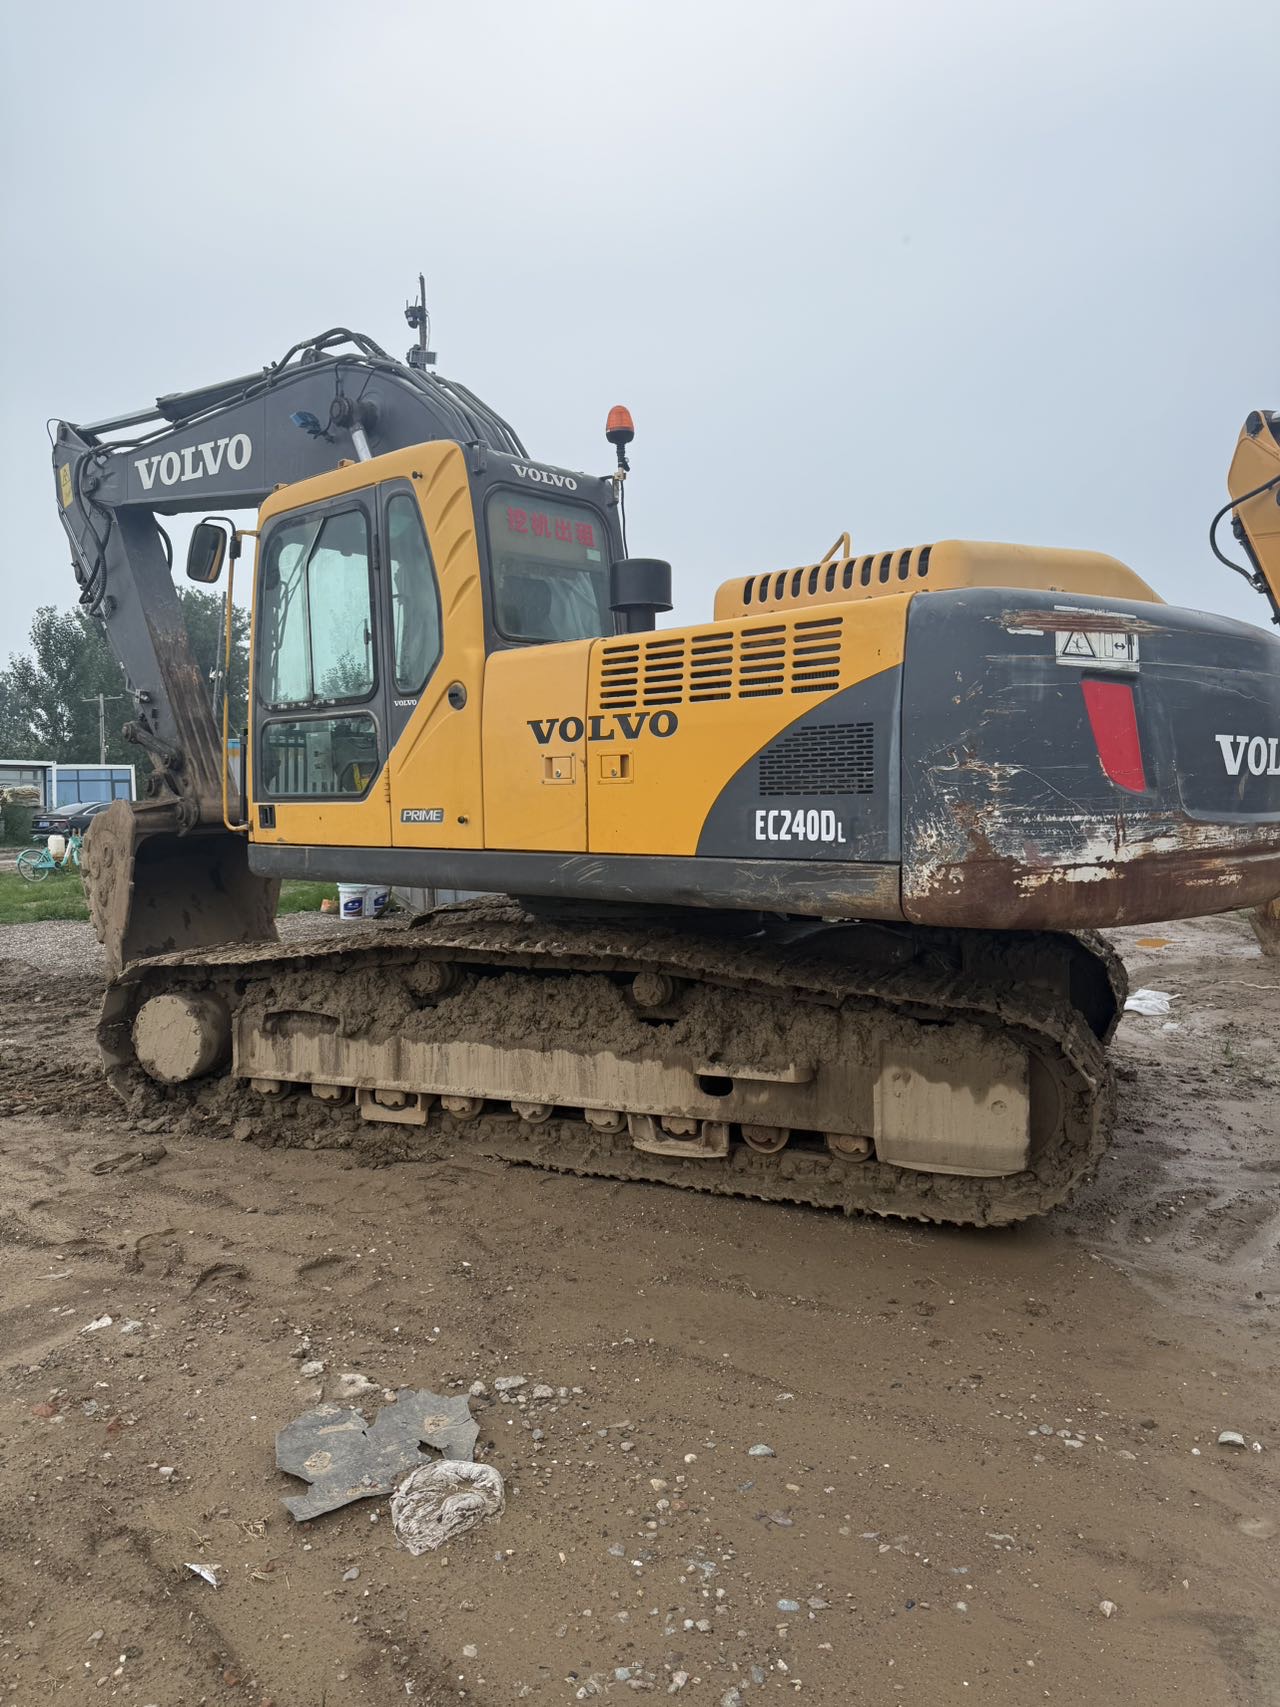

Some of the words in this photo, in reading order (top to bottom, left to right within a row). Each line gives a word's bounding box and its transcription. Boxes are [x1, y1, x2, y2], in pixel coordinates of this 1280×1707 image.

[134, 433, 252, 490] VOLVO
[511, 463, 577, 490] VOLVO
[394, 699, 417, 707] VOLVO
[526, 710, 679, 744] VOLVO
[402, 809, 443, 821] PRIME
